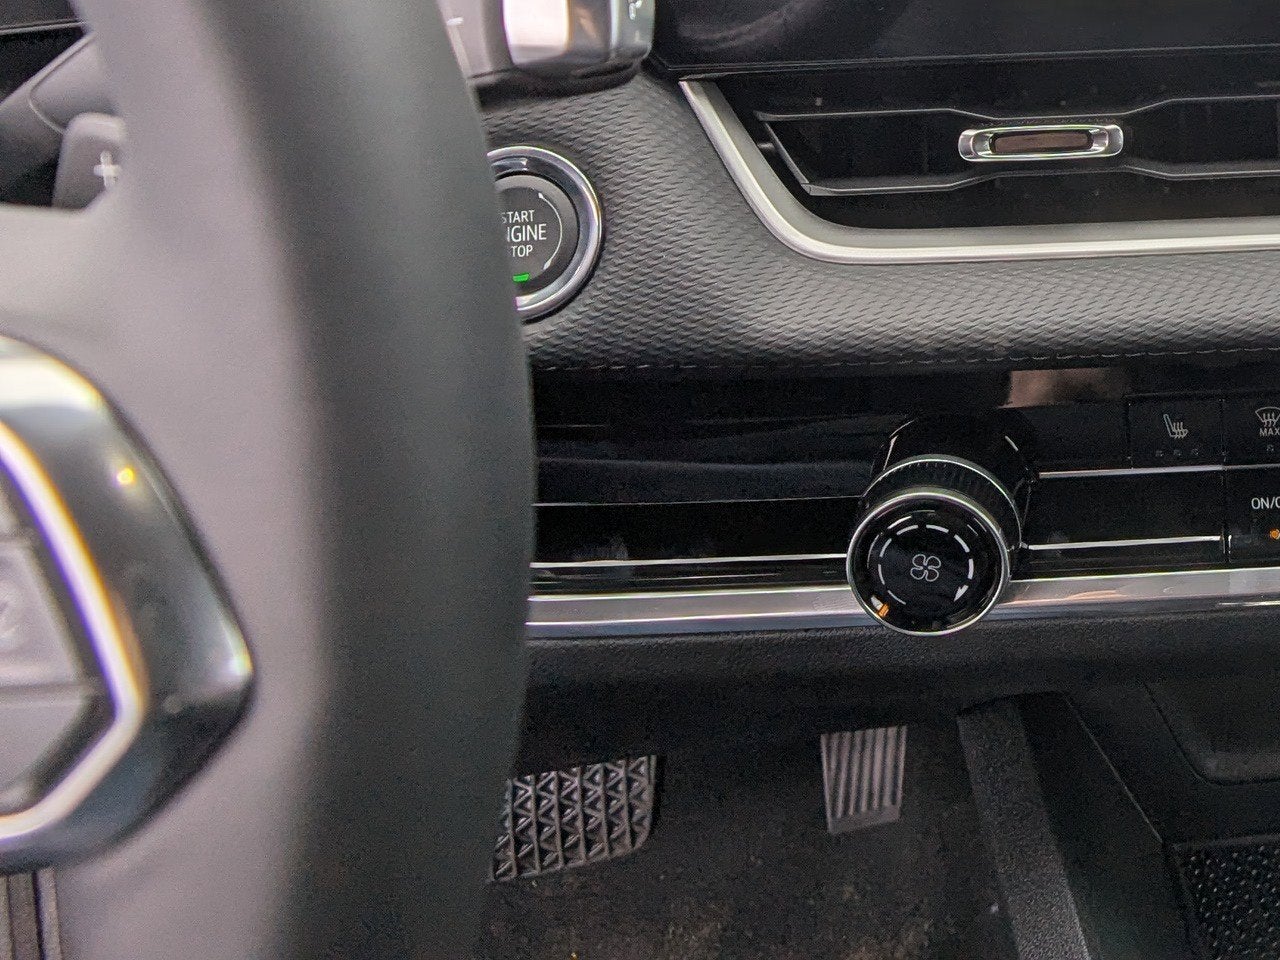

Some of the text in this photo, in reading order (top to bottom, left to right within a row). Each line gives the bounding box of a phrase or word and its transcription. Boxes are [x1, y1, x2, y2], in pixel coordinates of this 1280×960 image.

[501, 209, 535, 224] START
[506, 223, 547, 243] GINE
[510, 244, 533, 258] TOP
[1259, 427, 1280, 437] MAX
